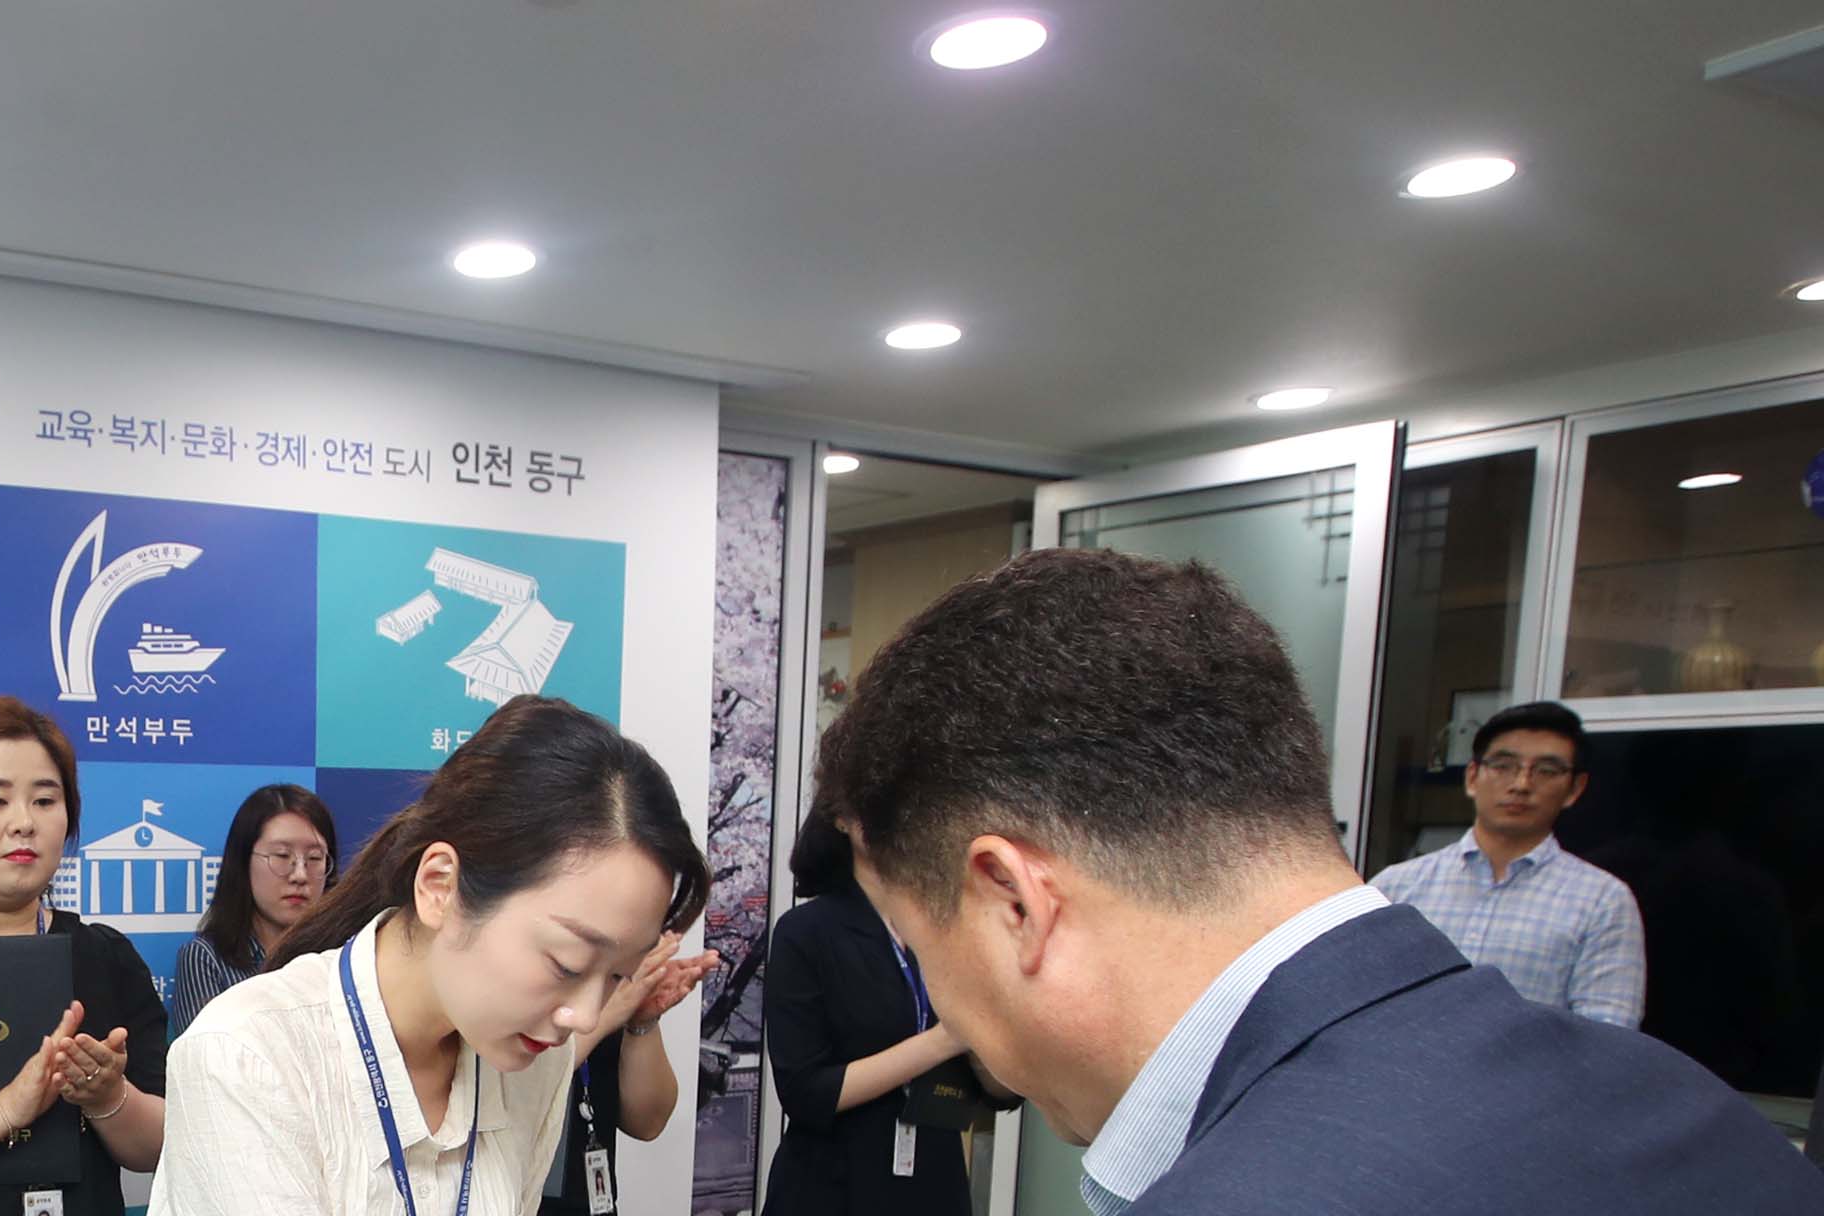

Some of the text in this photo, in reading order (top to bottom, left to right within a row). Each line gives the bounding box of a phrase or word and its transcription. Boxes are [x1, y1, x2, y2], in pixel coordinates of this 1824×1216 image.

[382, 446, 432, 484] 도시
[452, 442, 513, 488] 인천
[526, 449, 586, 496] 동구
[87, 716, 194, 745] 만석부두
